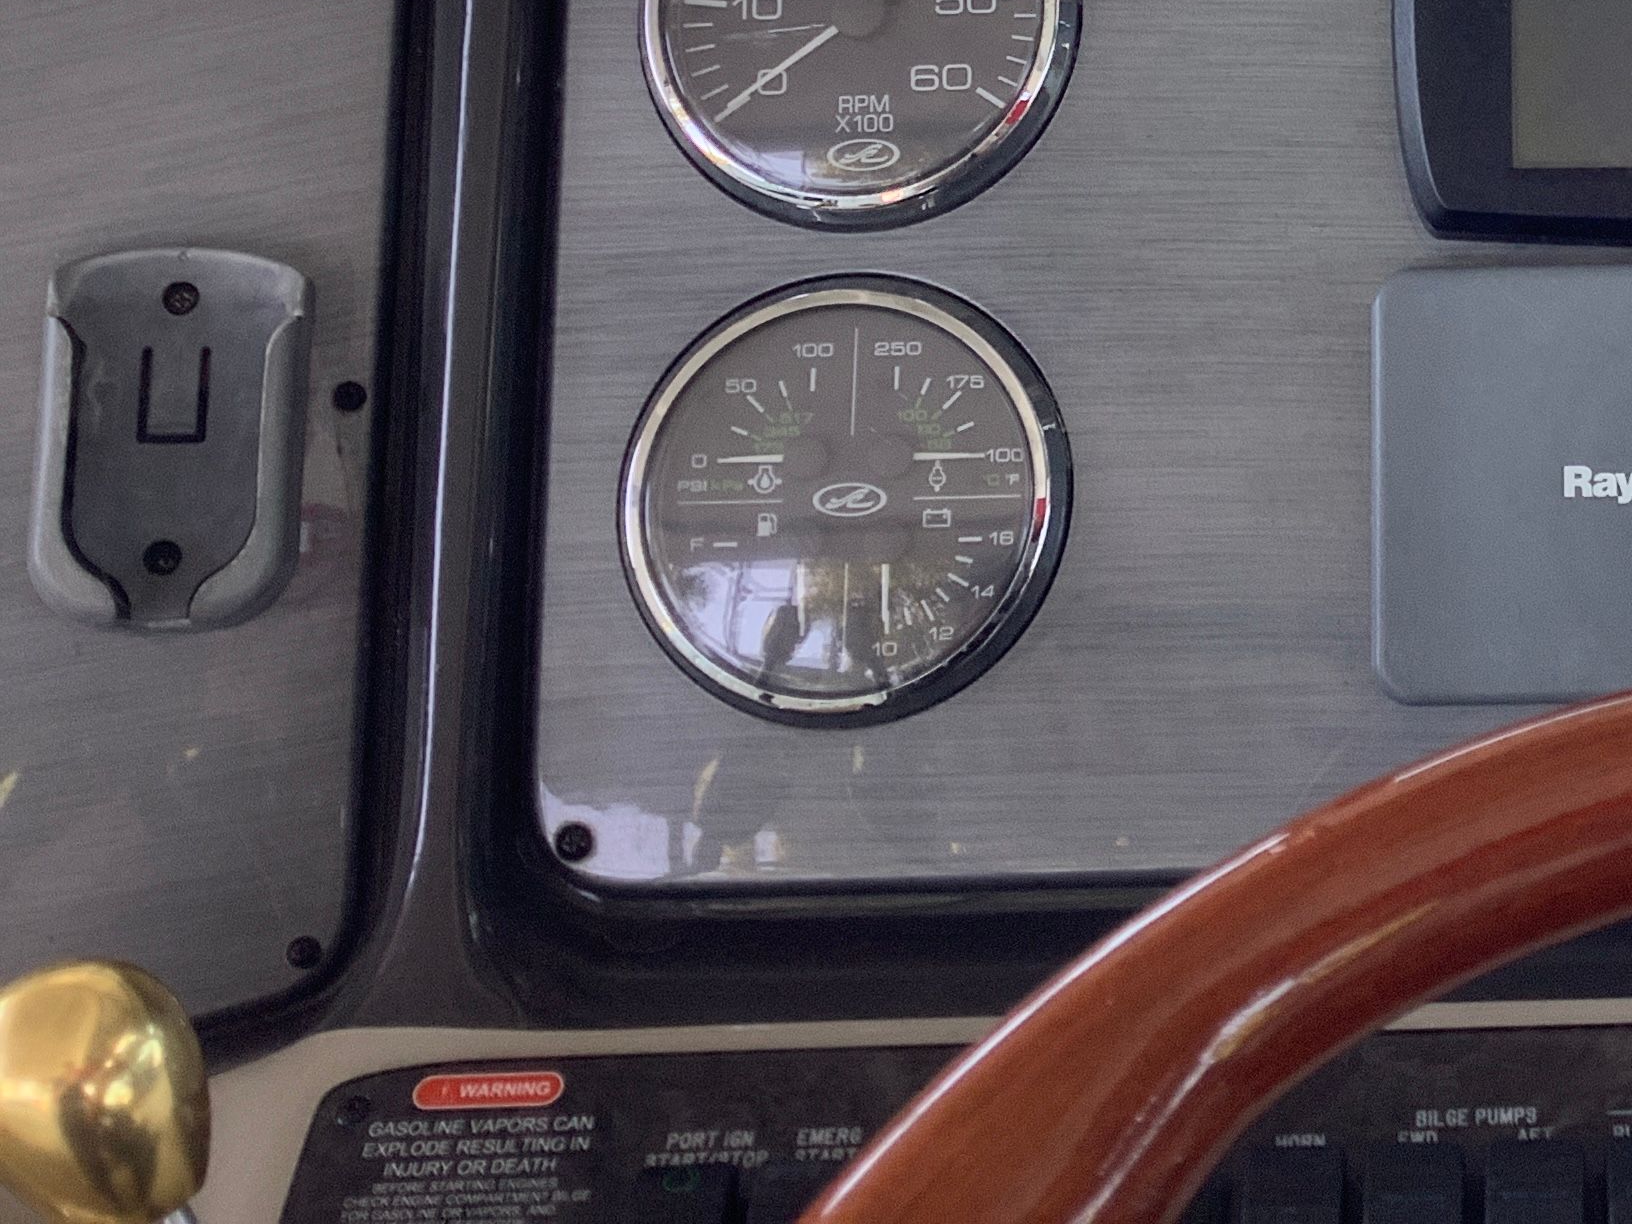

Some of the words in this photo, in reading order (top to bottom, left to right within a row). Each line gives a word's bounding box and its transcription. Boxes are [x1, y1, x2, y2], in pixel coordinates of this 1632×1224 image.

[757, 69, 787, 96] 0
[909, 64, 972, 91] 60
[838, 95, 889, 113] RPM
[835, 115, 894, 133] X100
[793, 343, 834, 358] 100
[874, 341, 922, 356] 250
[725, 378, 757, 394] 50
[946, 375, 985, 389] 175
[691, 453, 707, 469] 0
[986, 448, 1025, 463] 100
[690, 537, 704, 552] F
[988, 531, 1014, 546] 16
[970, 584, 995, 599] 14
[929, 626, 955, 641] 12
[872, 642, 898, 657] 10
[459, 1082, 551, 1097] WARNING
[1415, 1109, 1469, 1128] BILGE
[1475, 1106, 1538, 1126] PUMPS
[368, 1119, 466, 1138] GASOLINE
[470, 1117, 548, 1134] VAPORS
[553, 1115, 595, 1131] CAN
[362, 1141, 454, 1159] EXPLODE
[456, 1137, 566, 1155] RESULTING
[568, 1136, 592, 1153] IN
[666, 1129, 720, 1150] PORT
[383, 1161, 453, 1178] INJURY
[457, 1160, 487, 1176] OR
[490, 1157, 558, 1175] DEATH
